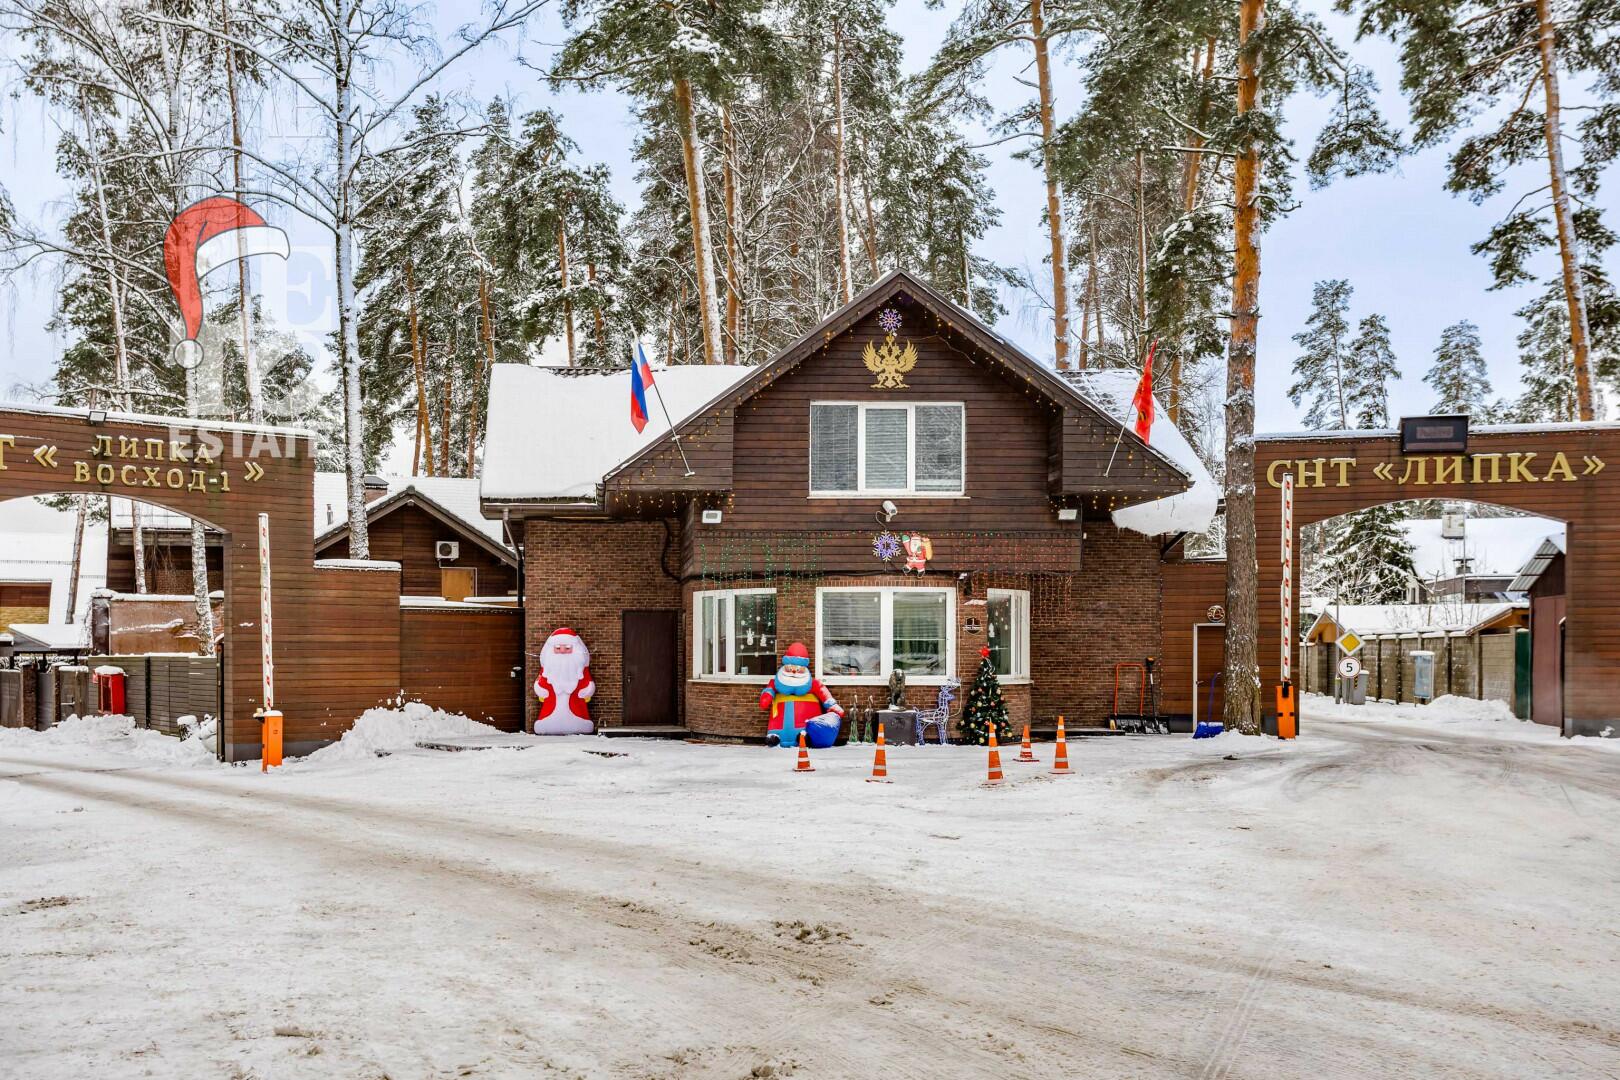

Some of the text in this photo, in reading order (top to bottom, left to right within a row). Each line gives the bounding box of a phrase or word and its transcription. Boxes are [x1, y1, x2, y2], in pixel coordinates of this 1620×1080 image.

[1266, 452, 1606, 489] СНТ «ЛИПКА»
[1346, 663, 1353, 672] 5
